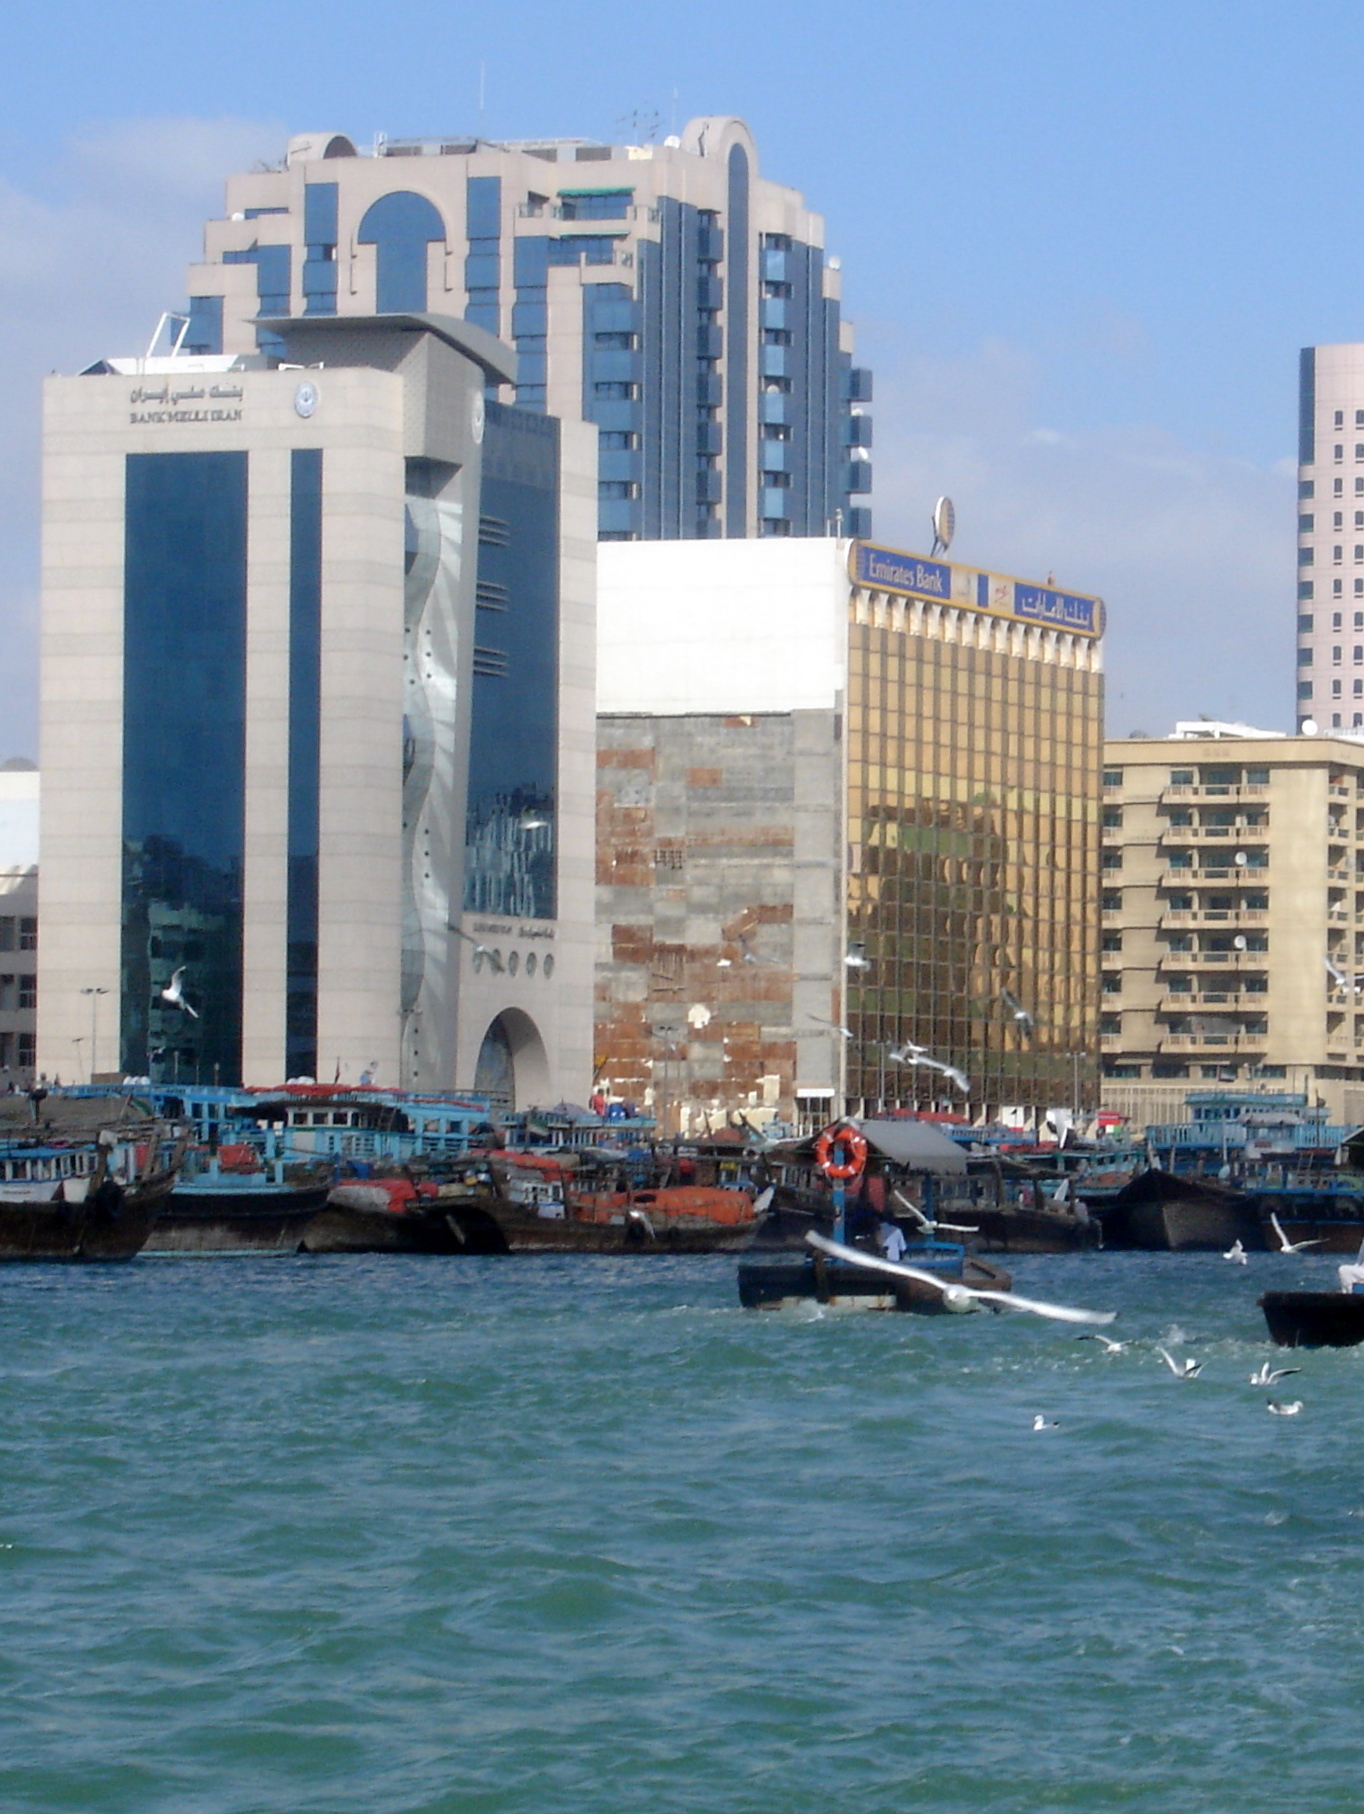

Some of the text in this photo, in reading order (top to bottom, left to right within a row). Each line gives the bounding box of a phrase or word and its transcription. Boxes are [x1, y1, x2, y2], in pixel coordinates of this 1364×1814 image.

[130, 408, 243, 424] BANK MELLI IRAN
[869, 553, 943, 593] Emirates Bank
